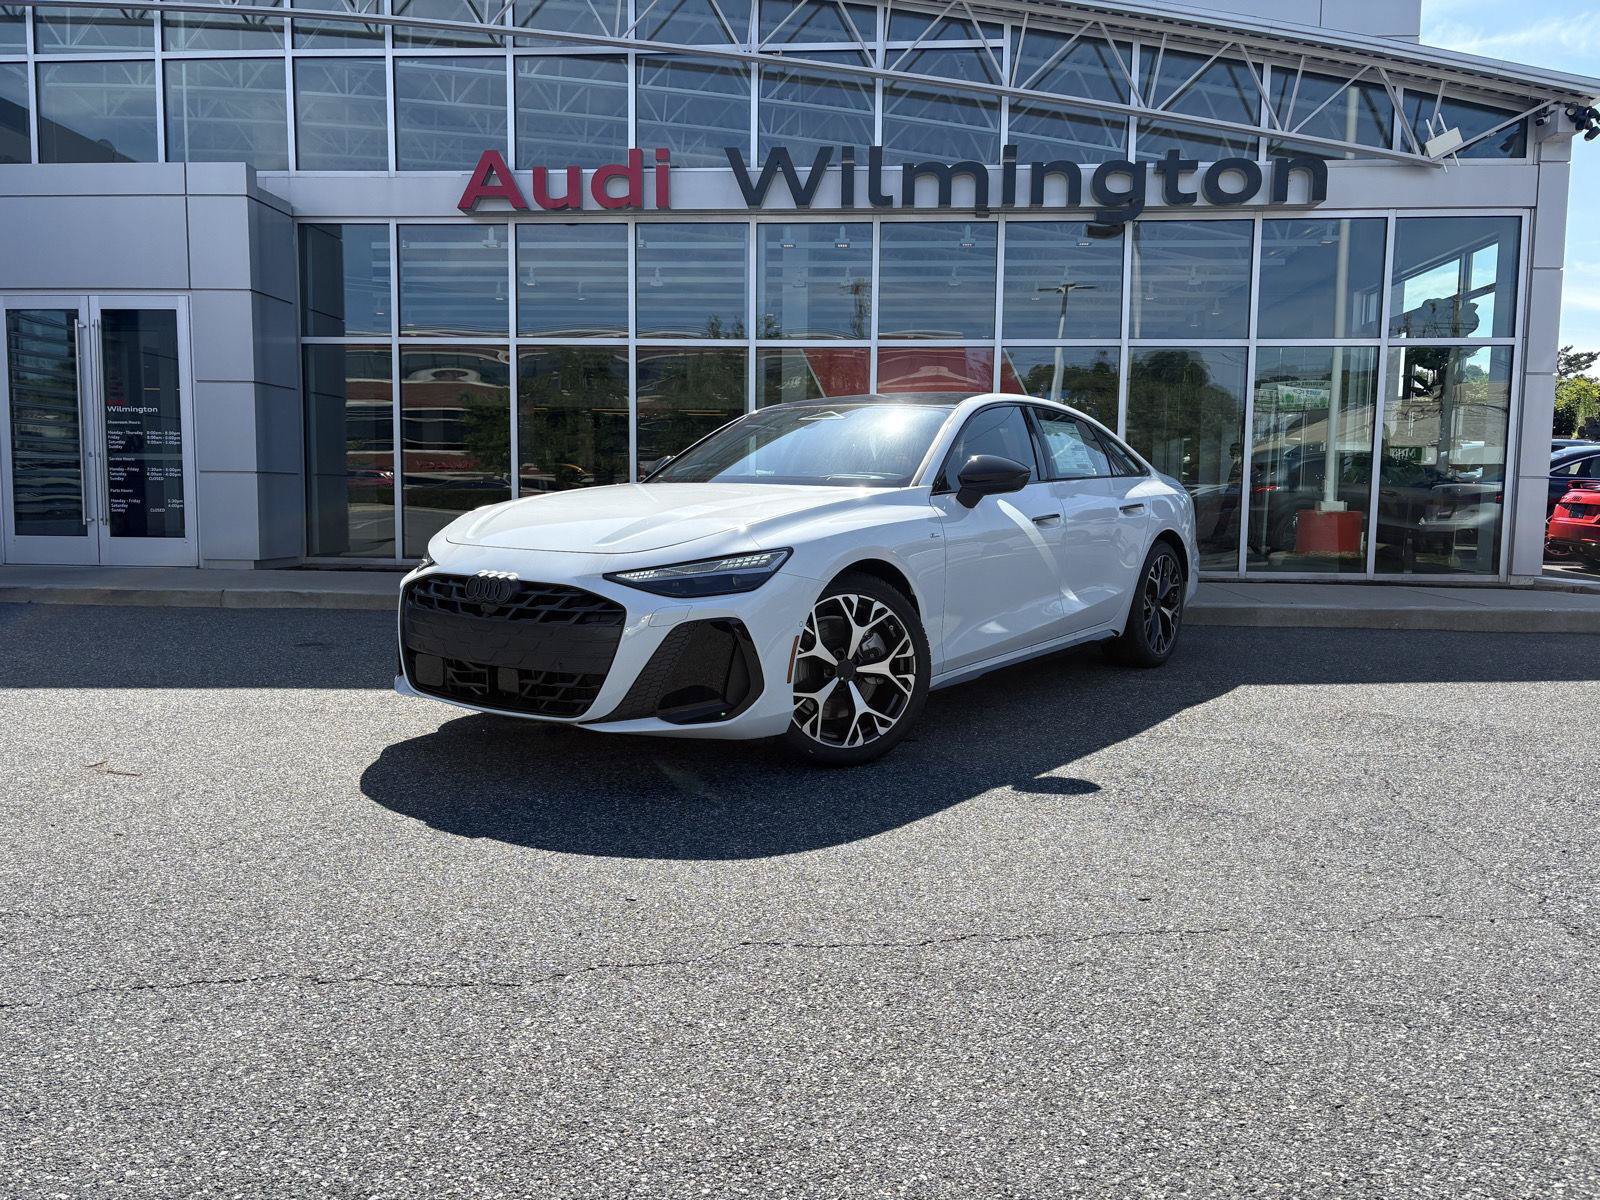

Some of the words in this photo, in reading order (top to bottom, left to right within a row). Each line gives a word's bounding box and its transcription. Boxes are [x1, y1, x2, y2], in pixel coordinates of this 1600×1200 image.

[458, 148, 671, 212] Audi
[724, 144, 1328, 226] Wilmington
[106, 405, 158, 414] Wilmington
